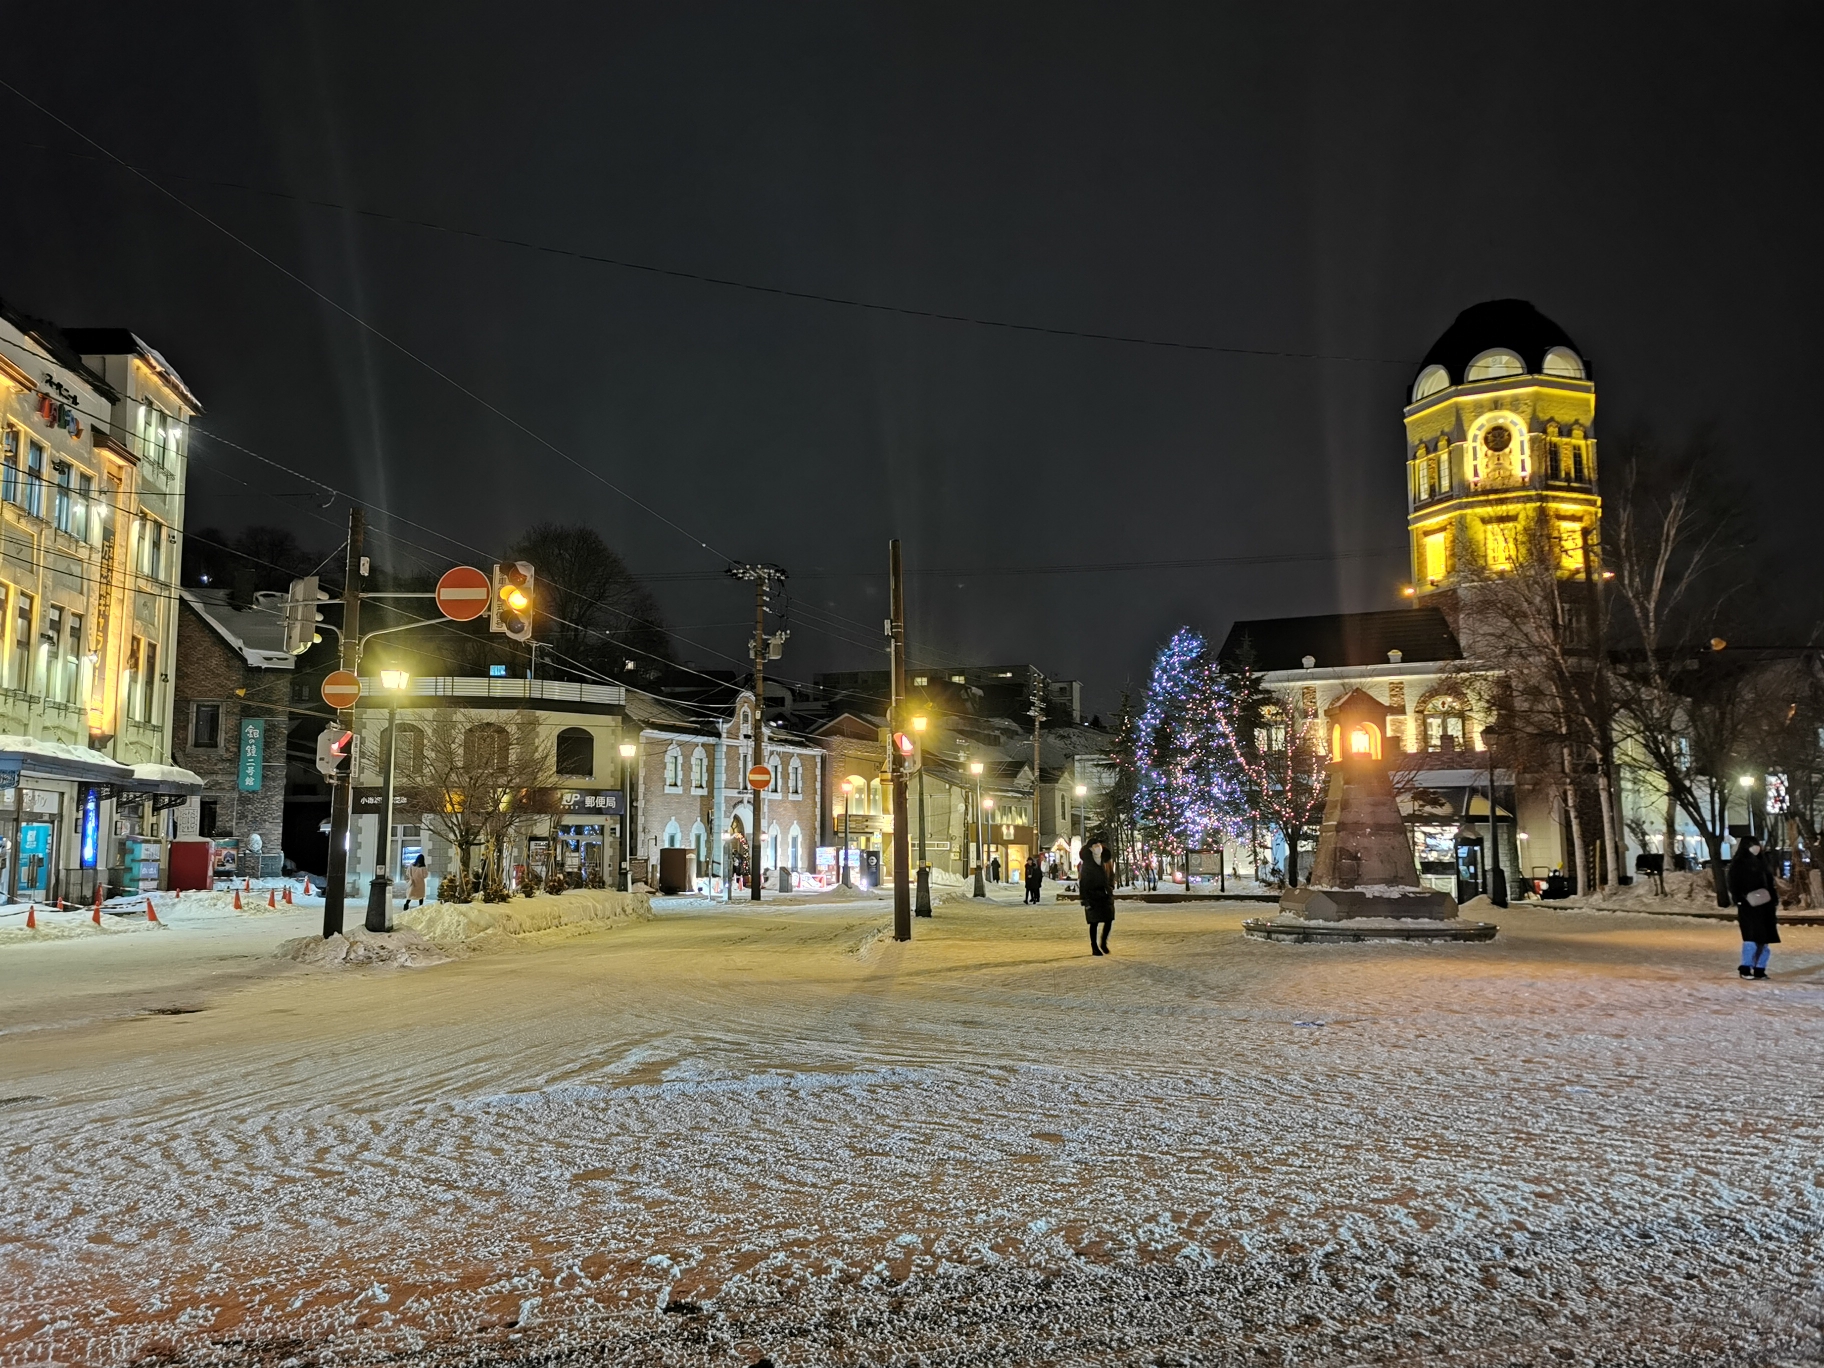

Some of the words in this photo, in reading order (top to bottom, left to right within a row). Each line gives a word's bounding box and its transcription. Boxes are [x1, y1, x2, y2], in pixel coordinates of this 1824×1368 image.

[244, 724, 260, 786] 銀の鐘二号館
[584, 795, 616, 809] 郵便局
